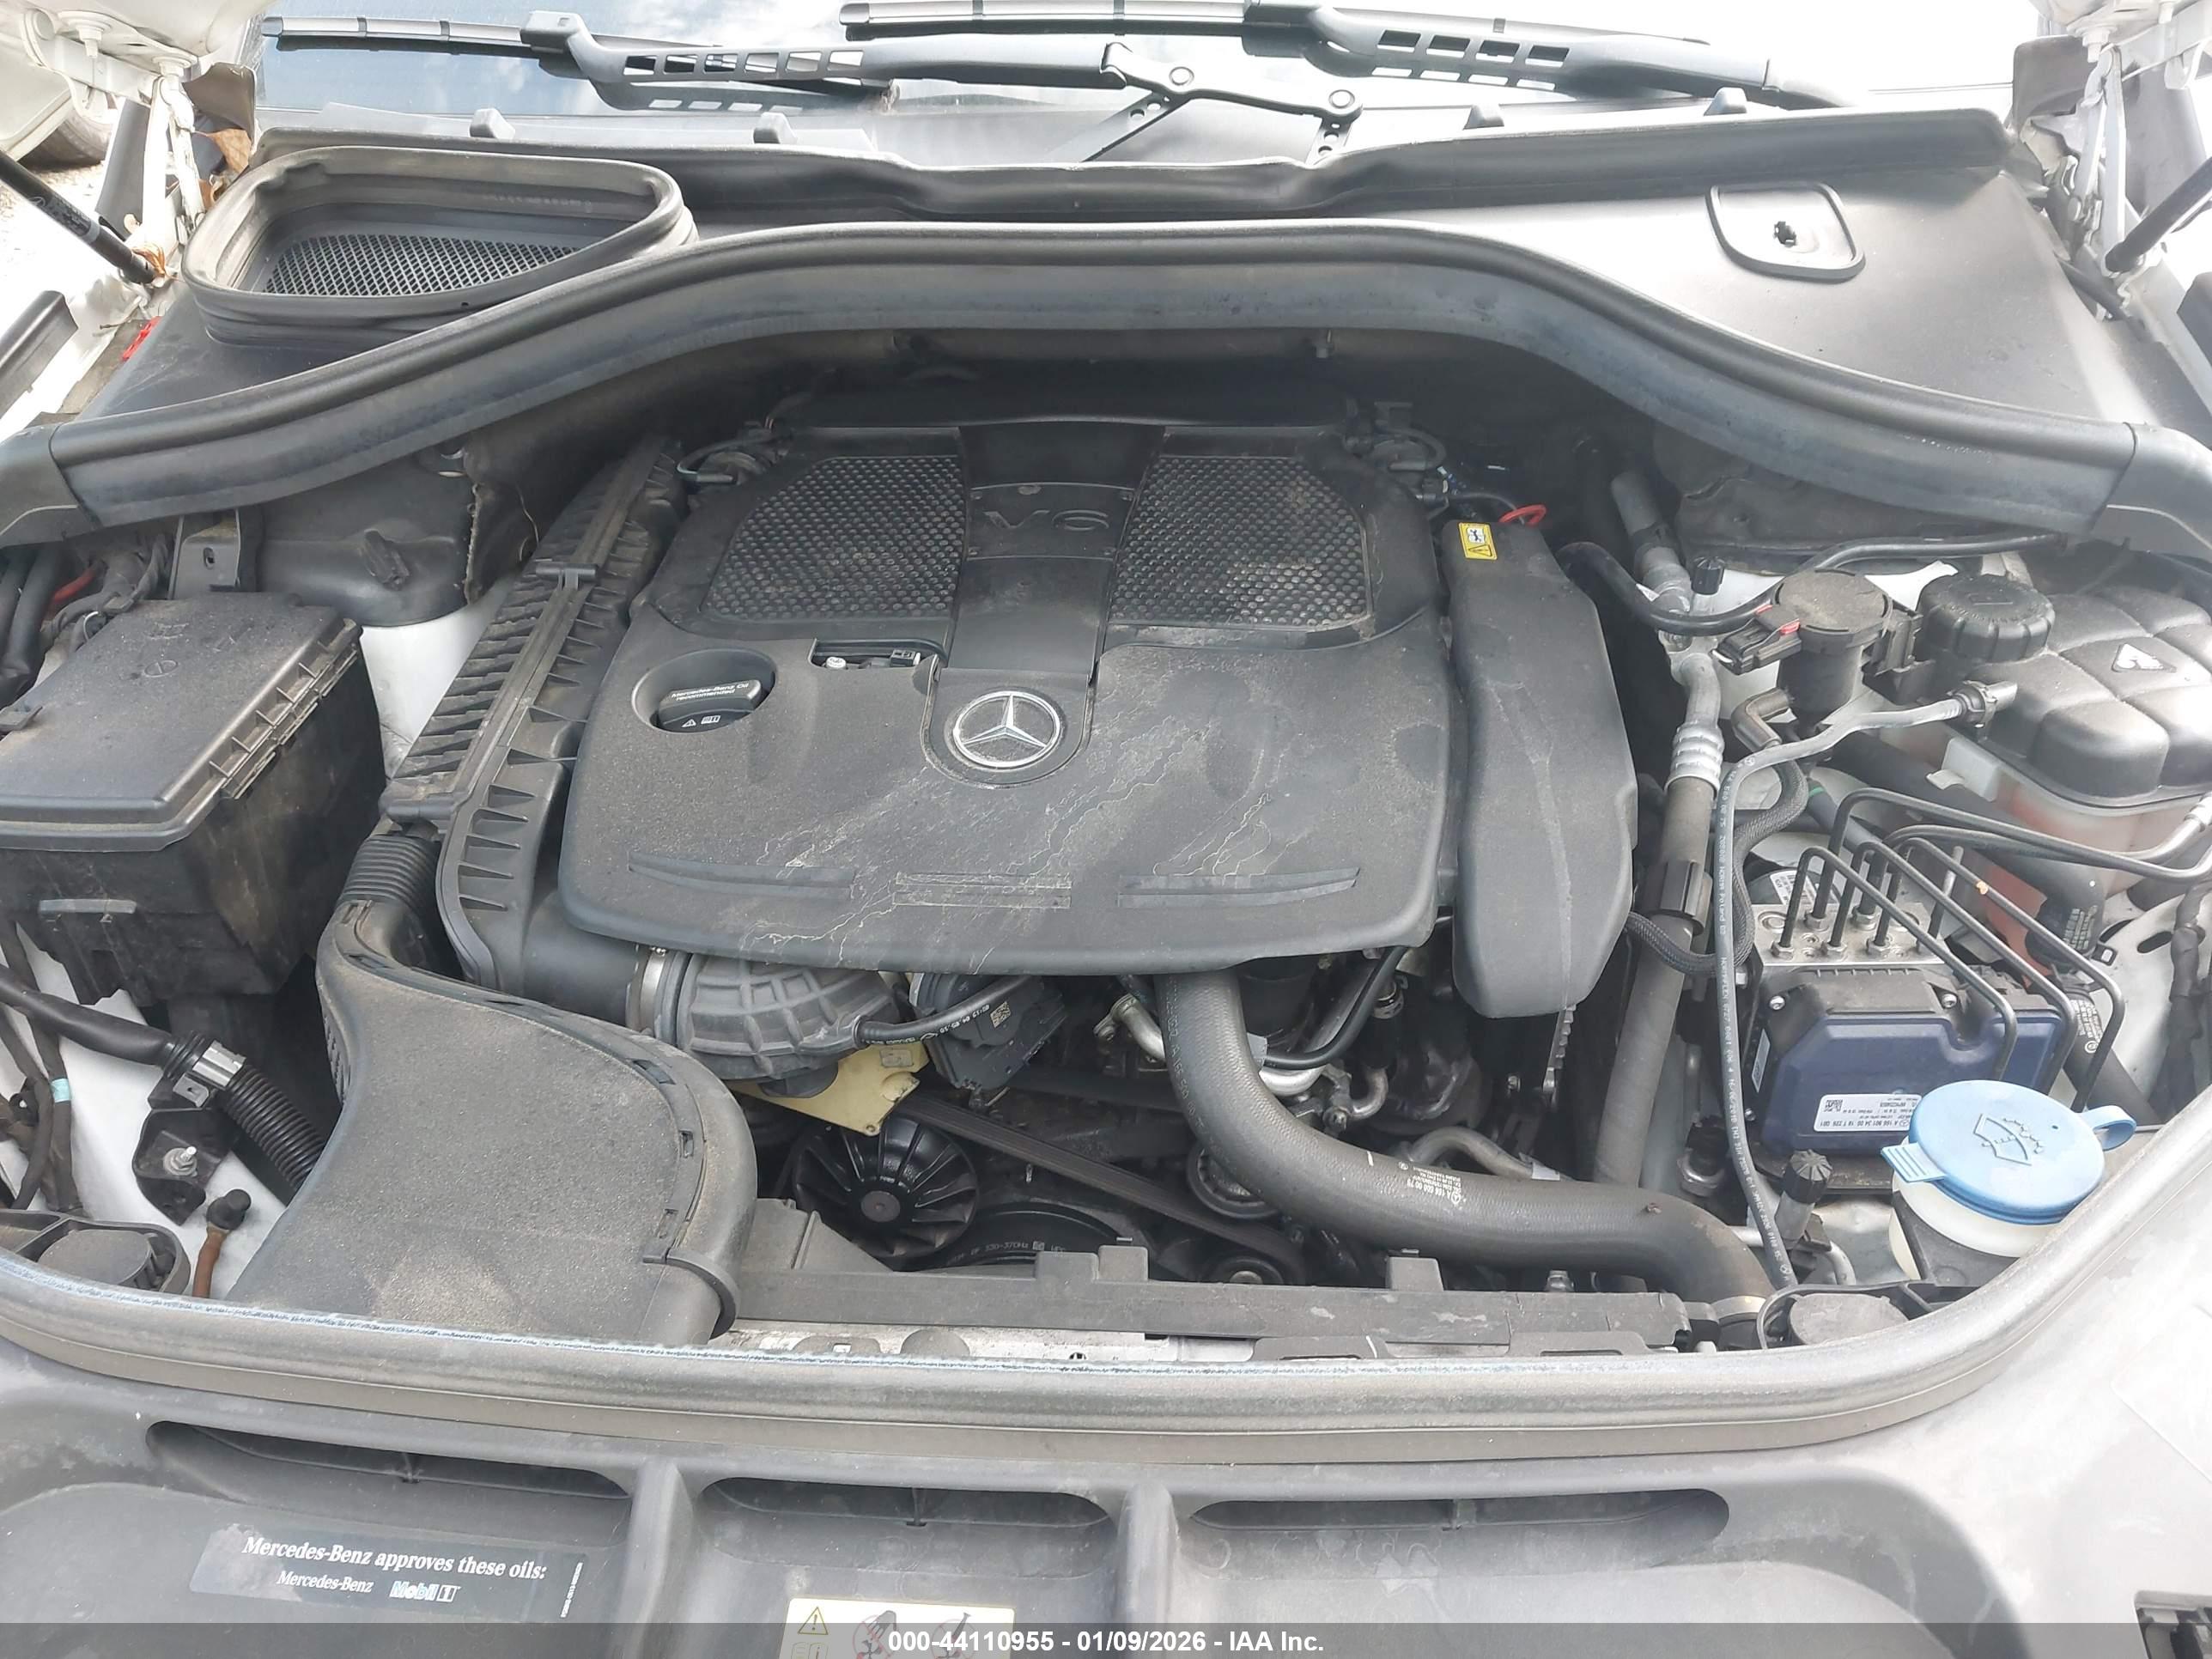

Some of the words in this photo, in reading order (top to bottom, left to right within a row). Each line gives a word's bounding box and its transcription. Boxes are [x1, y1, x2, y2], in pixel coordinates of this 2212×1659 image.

[671, 685, 736, 699] Mercedes-Benz
[676, 689, 736, 701] recommended
[1718, 892, 1727, 921] Poland
[241, 1537, 373, 1566] Mercedes-Benz
[374, 1551, 455, 1574] approves
[457, 1556, 505, 1577] these
[508, 1561, 548, 1580] oils:
[276, 1571, 374, 1593] Mercedes-Benz
[389, 1580, 440, 1601] Mobil
